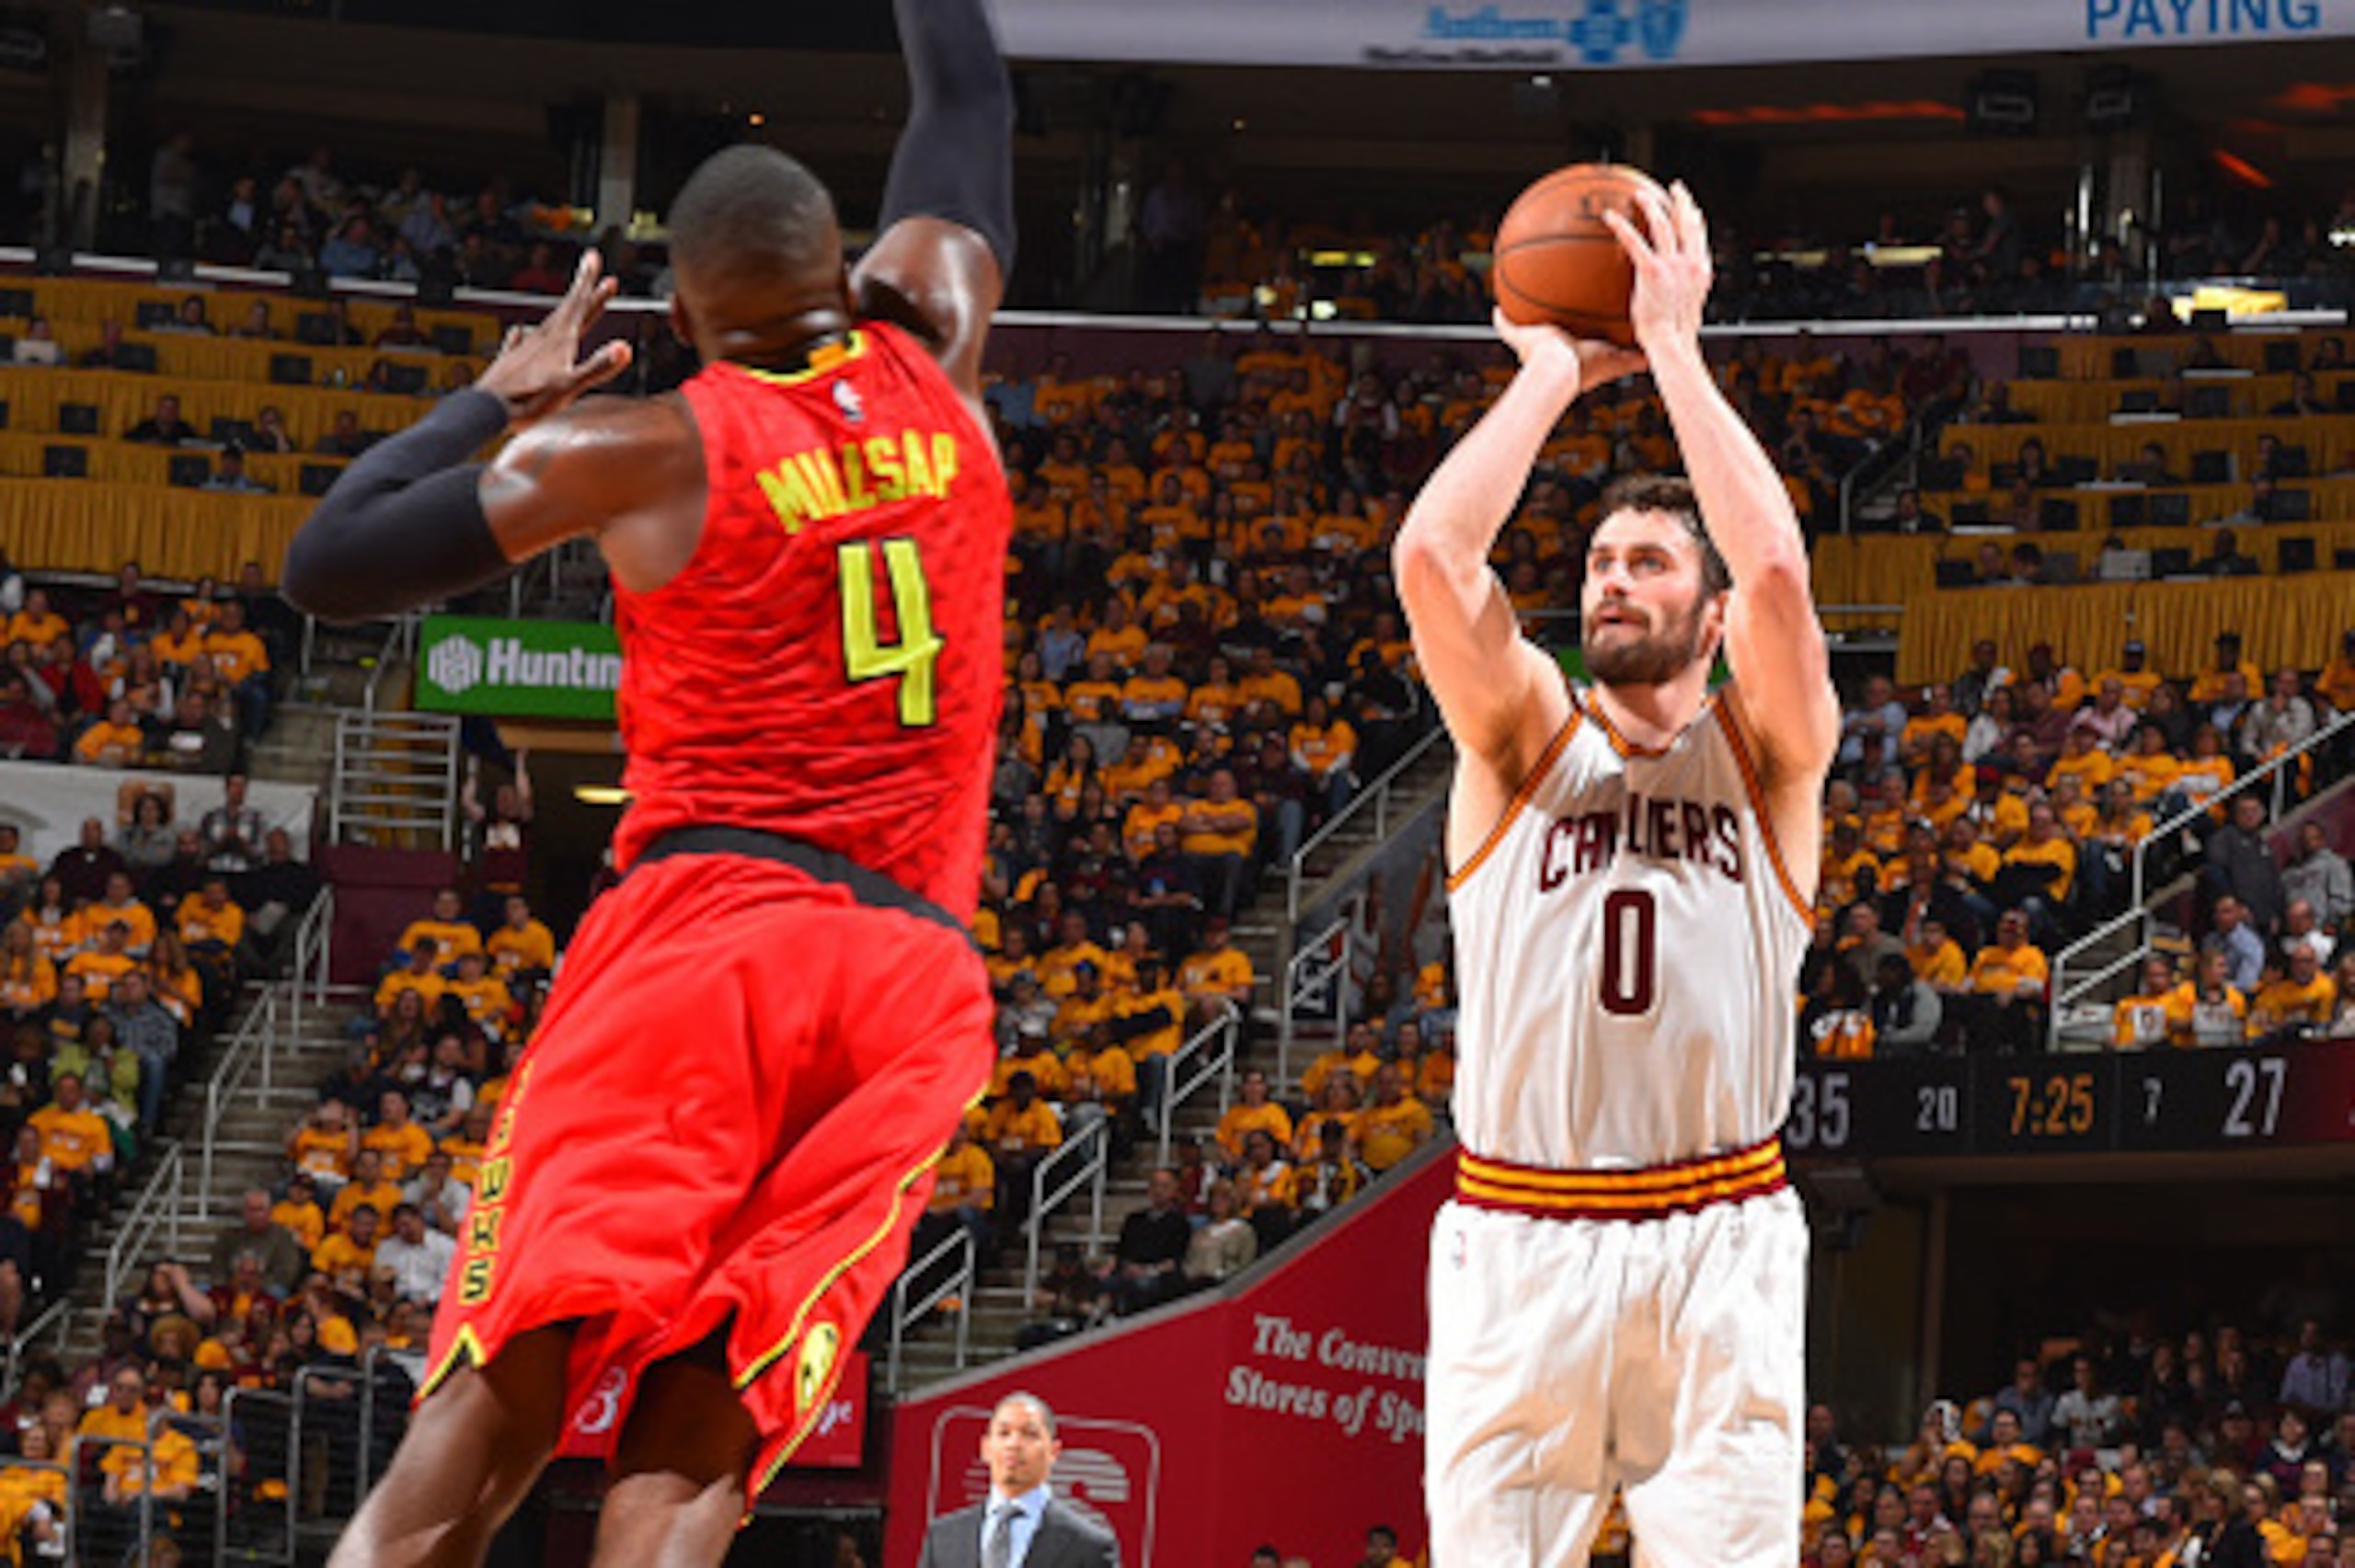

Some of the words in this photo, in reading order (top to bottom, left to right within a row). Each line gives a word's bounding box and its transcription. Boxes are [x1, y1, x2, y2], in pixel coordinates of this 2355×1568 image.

[2087, 0, 2321, 39] PAYING
[755, 428, 958, 534] MILLSAP
[839, 537, 944, 728] 4
[1600, 889, 1656, 1015] 0
[1786, 1072, 1849, 1147] 35
[1916, 1086, 1958, 1131] 20
[2008, 1072, 2094, 1136] 7:25
[2223, 1059, 2287, 1136] 27
[1253, 1313, 1313, 1360] The
[1224, 1365, 1328, 1418] Stores
[1334, 1385, 1374, 1437] of
